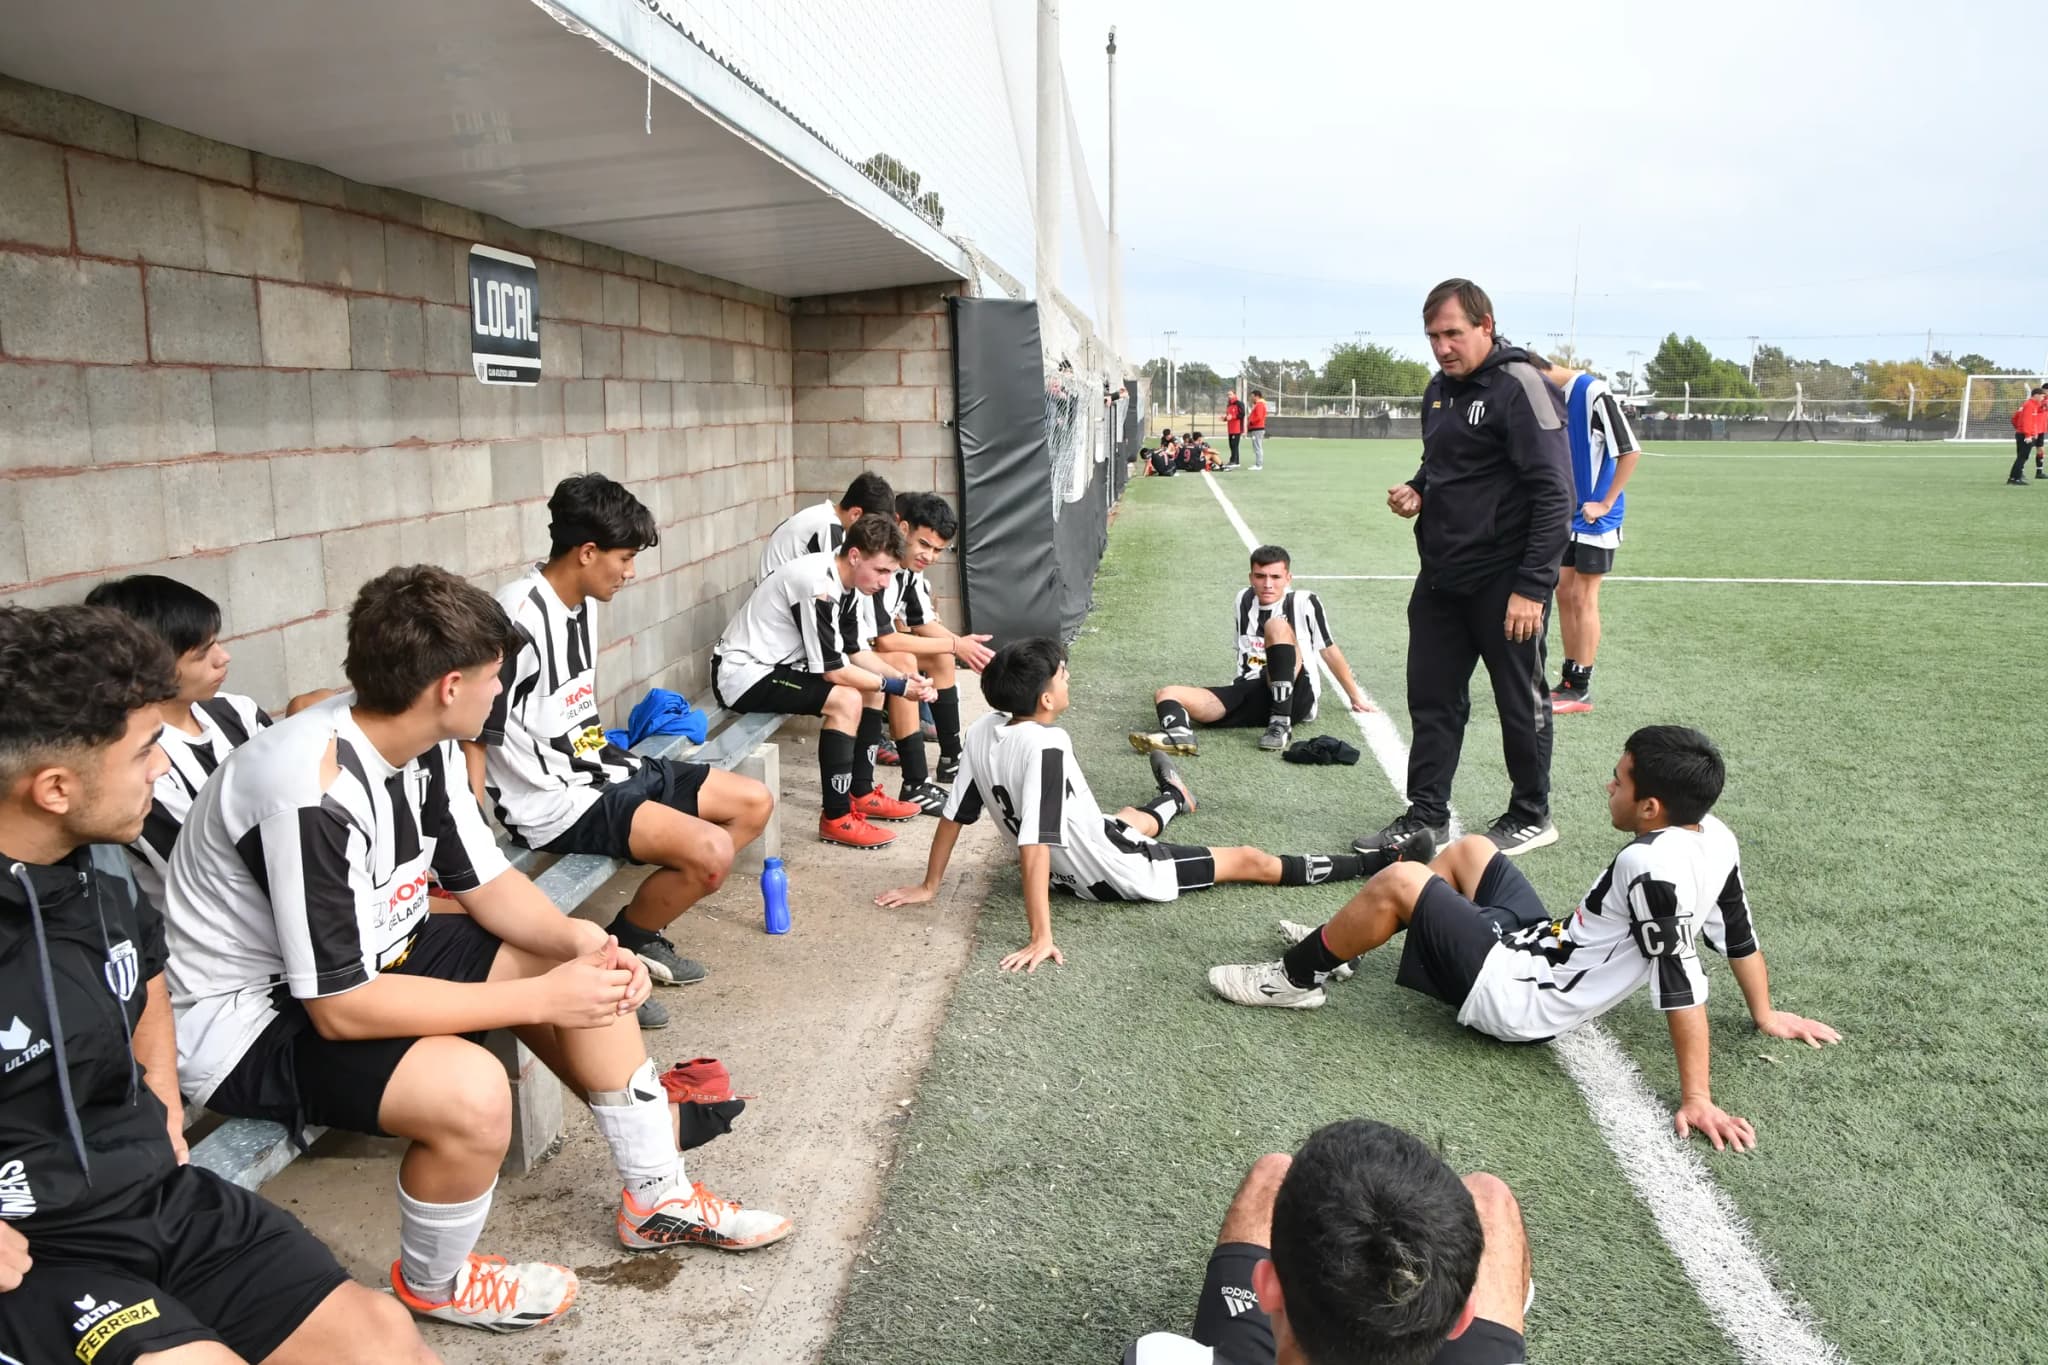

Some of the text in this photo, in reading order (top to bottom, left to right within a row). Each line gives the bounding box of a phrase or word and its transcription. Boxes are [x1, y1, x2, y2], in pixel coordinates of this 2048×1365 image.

[473, 277, 538, 342] LOCAL
[1641, 921, 1665, 956] C
[5, 1038, 52, 1073] ULTRA
[73, 1300, 123, 1332] ULTRA
[80, 1305, 152, 1360] FERREIRA
